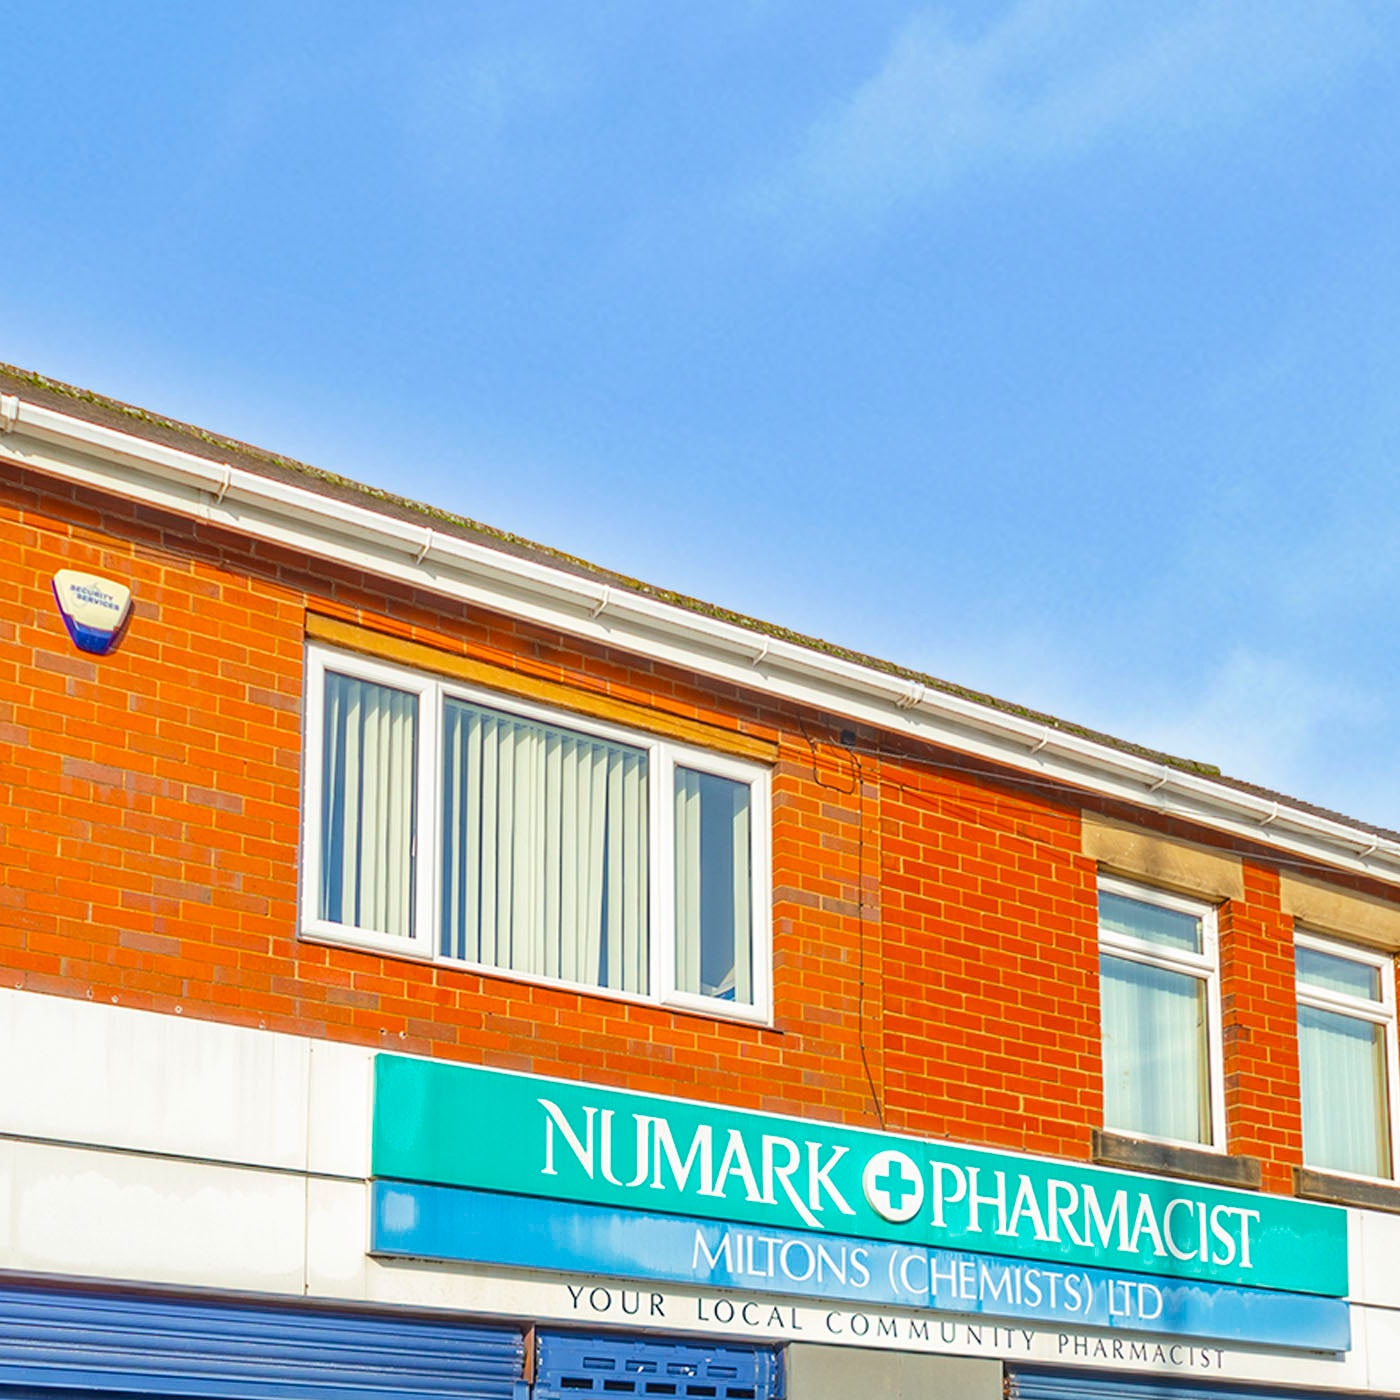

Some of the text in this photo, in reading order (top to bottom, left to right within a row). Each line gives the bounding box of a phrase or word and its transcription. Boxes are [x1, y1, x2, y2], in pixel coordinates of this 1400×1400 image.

[70, 584, 113, 600] SECURITY
[77, 593, 119, 611] SERVICES
[537, 1098, 1261, 1269] NUMARK PHARMACIST
[692, 1230, 1163, 1320] MILTONS (CHEMISTS) LTD
[567, 1285, 1225, 1370] YOUR LOCAL COMMUNITY PHARMACIST
